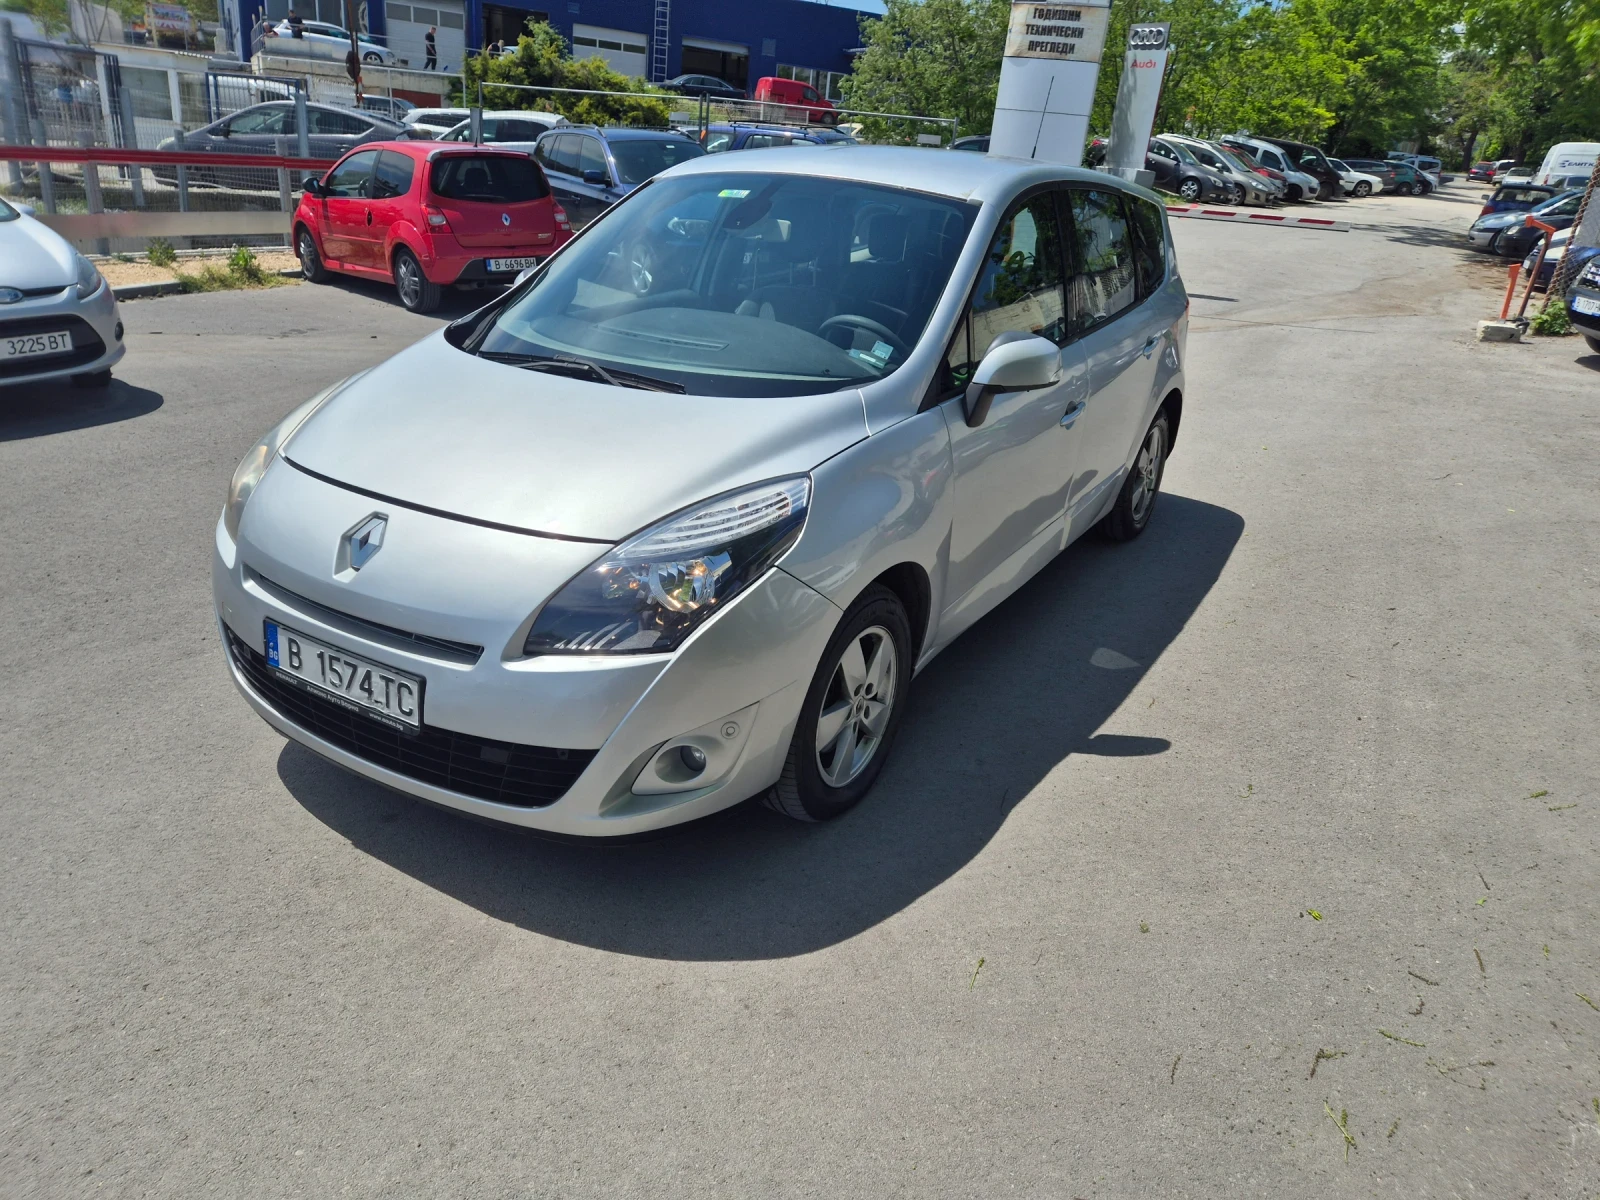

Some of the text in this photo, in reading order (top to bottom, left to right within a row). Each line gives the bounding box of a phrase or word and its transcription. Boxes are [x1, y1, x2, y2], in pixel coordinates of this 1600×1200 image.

[1033, 8, 1082, 22] ГОДИШНИ
[1025, 24, 1085, 38] ТЕХНИЧЕСКИ
[1027, 40, 1076, 55] ПРЕГЛЕДИ
[1130, 59, 1157, 69] Audi
[494, 260, 501, 270] B
[504, 259, 524, 270] 6696
[7, 333, 67, 355] 3225 BT
[268, 648, 279, 661] BG
[287, 637, 302, 671] B
[316, 649, 374, 700] 1574
